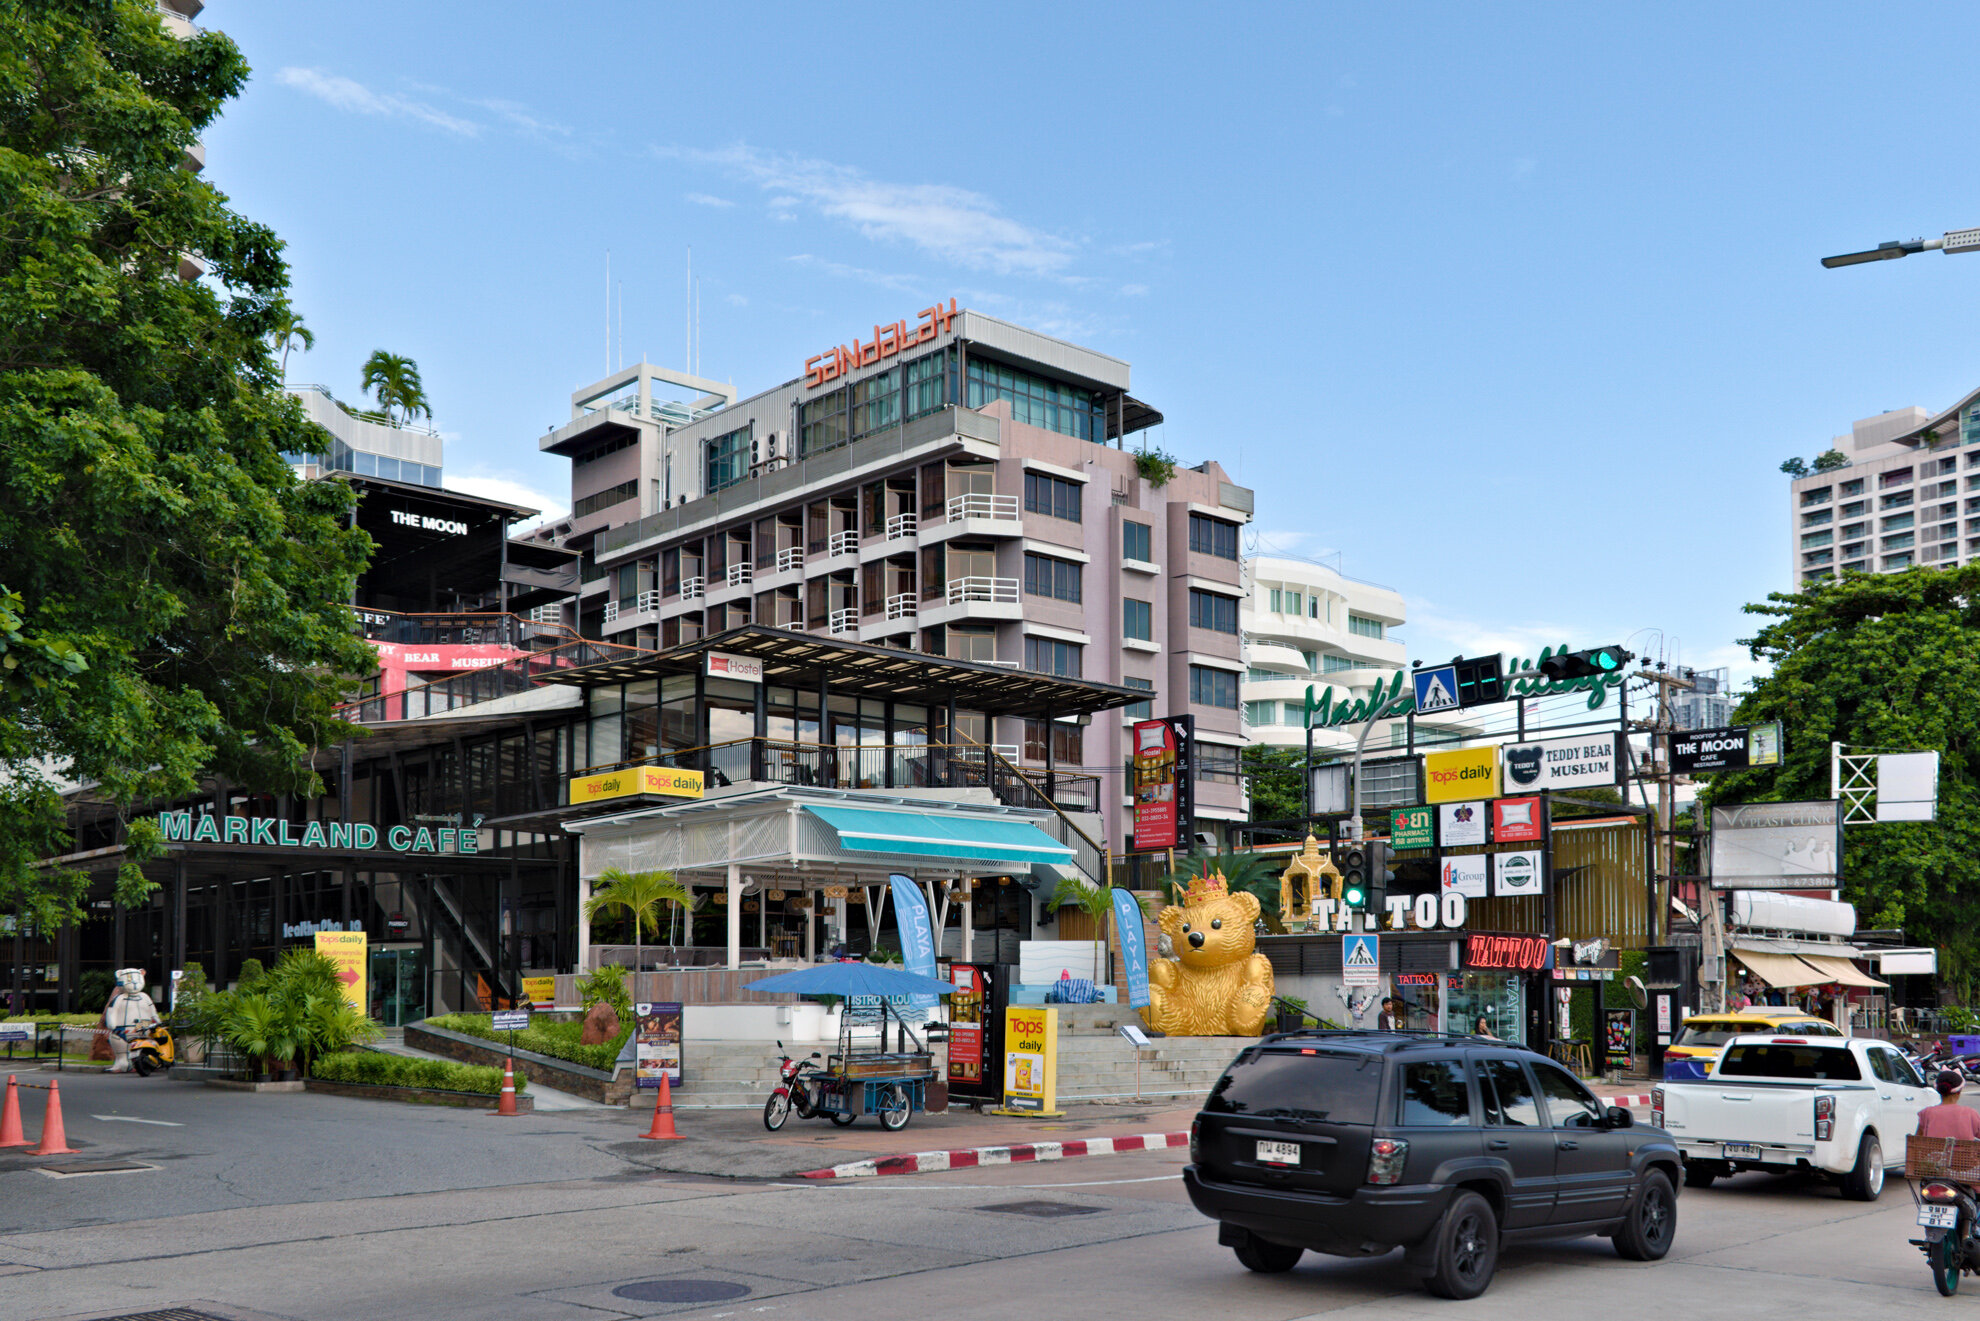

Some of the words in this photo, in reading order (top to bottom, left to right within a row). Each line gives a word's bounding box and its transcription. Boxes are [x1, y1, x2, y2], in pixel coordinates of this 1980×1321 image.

[390, 510, 420, 527] THE
[422, 516, 468, 536] MOON
[404, 653, 440, 663] BEAR
[730, 660, 762, 676] Hostel
[1690, 732, 1717, 740] ROOFTOP
[1143, 748, 1161, 757] Hostel
[1675, 742, 1697, 755] THE
[1701, 737, 1744, 753] MOON
[1546, 747, 1581, 763] TEDDY
[1583, 744, 1612, 759] BEAR
[1514, 761, 1535, 770] TEDDY
[1551, 761, 1609, 778] MUSEUM
[1693, 760, 1726, 768] RESTAURANT
[1429, 770, 1459, 786] Tops
[1460, 764, 1492, 780] daily
[586, 783, 603, 796] Tops
[603, 779, 621, 792] daily
[645, 774, 672, 790] Tops
[673, 777, 702, 793] daily
[1790, 815, 1837, 826] CLINIC
[159, 811, 378, 850] MARKLAND
[1395, 829, 1430, 837] PHARMACY
[1458, 871, 1485, 882] Group
[911, 904, 931, 958] PLAYA
[1121, 903, 1141, 972] PLAYA
[318, 935, 339, 944] Tops
[339, 935, 363, 945] daily
[1468, 935, 1548, 969] TATTOO
[537, 978, 553, 986] daily
[1397, 974, 1434, 984] TATTOO
[1010, 1018, 1043, 1038] Tops
[1019, 1040, 1042, 1052] daily
[1275, 1143, 1298, 1155] 4894
